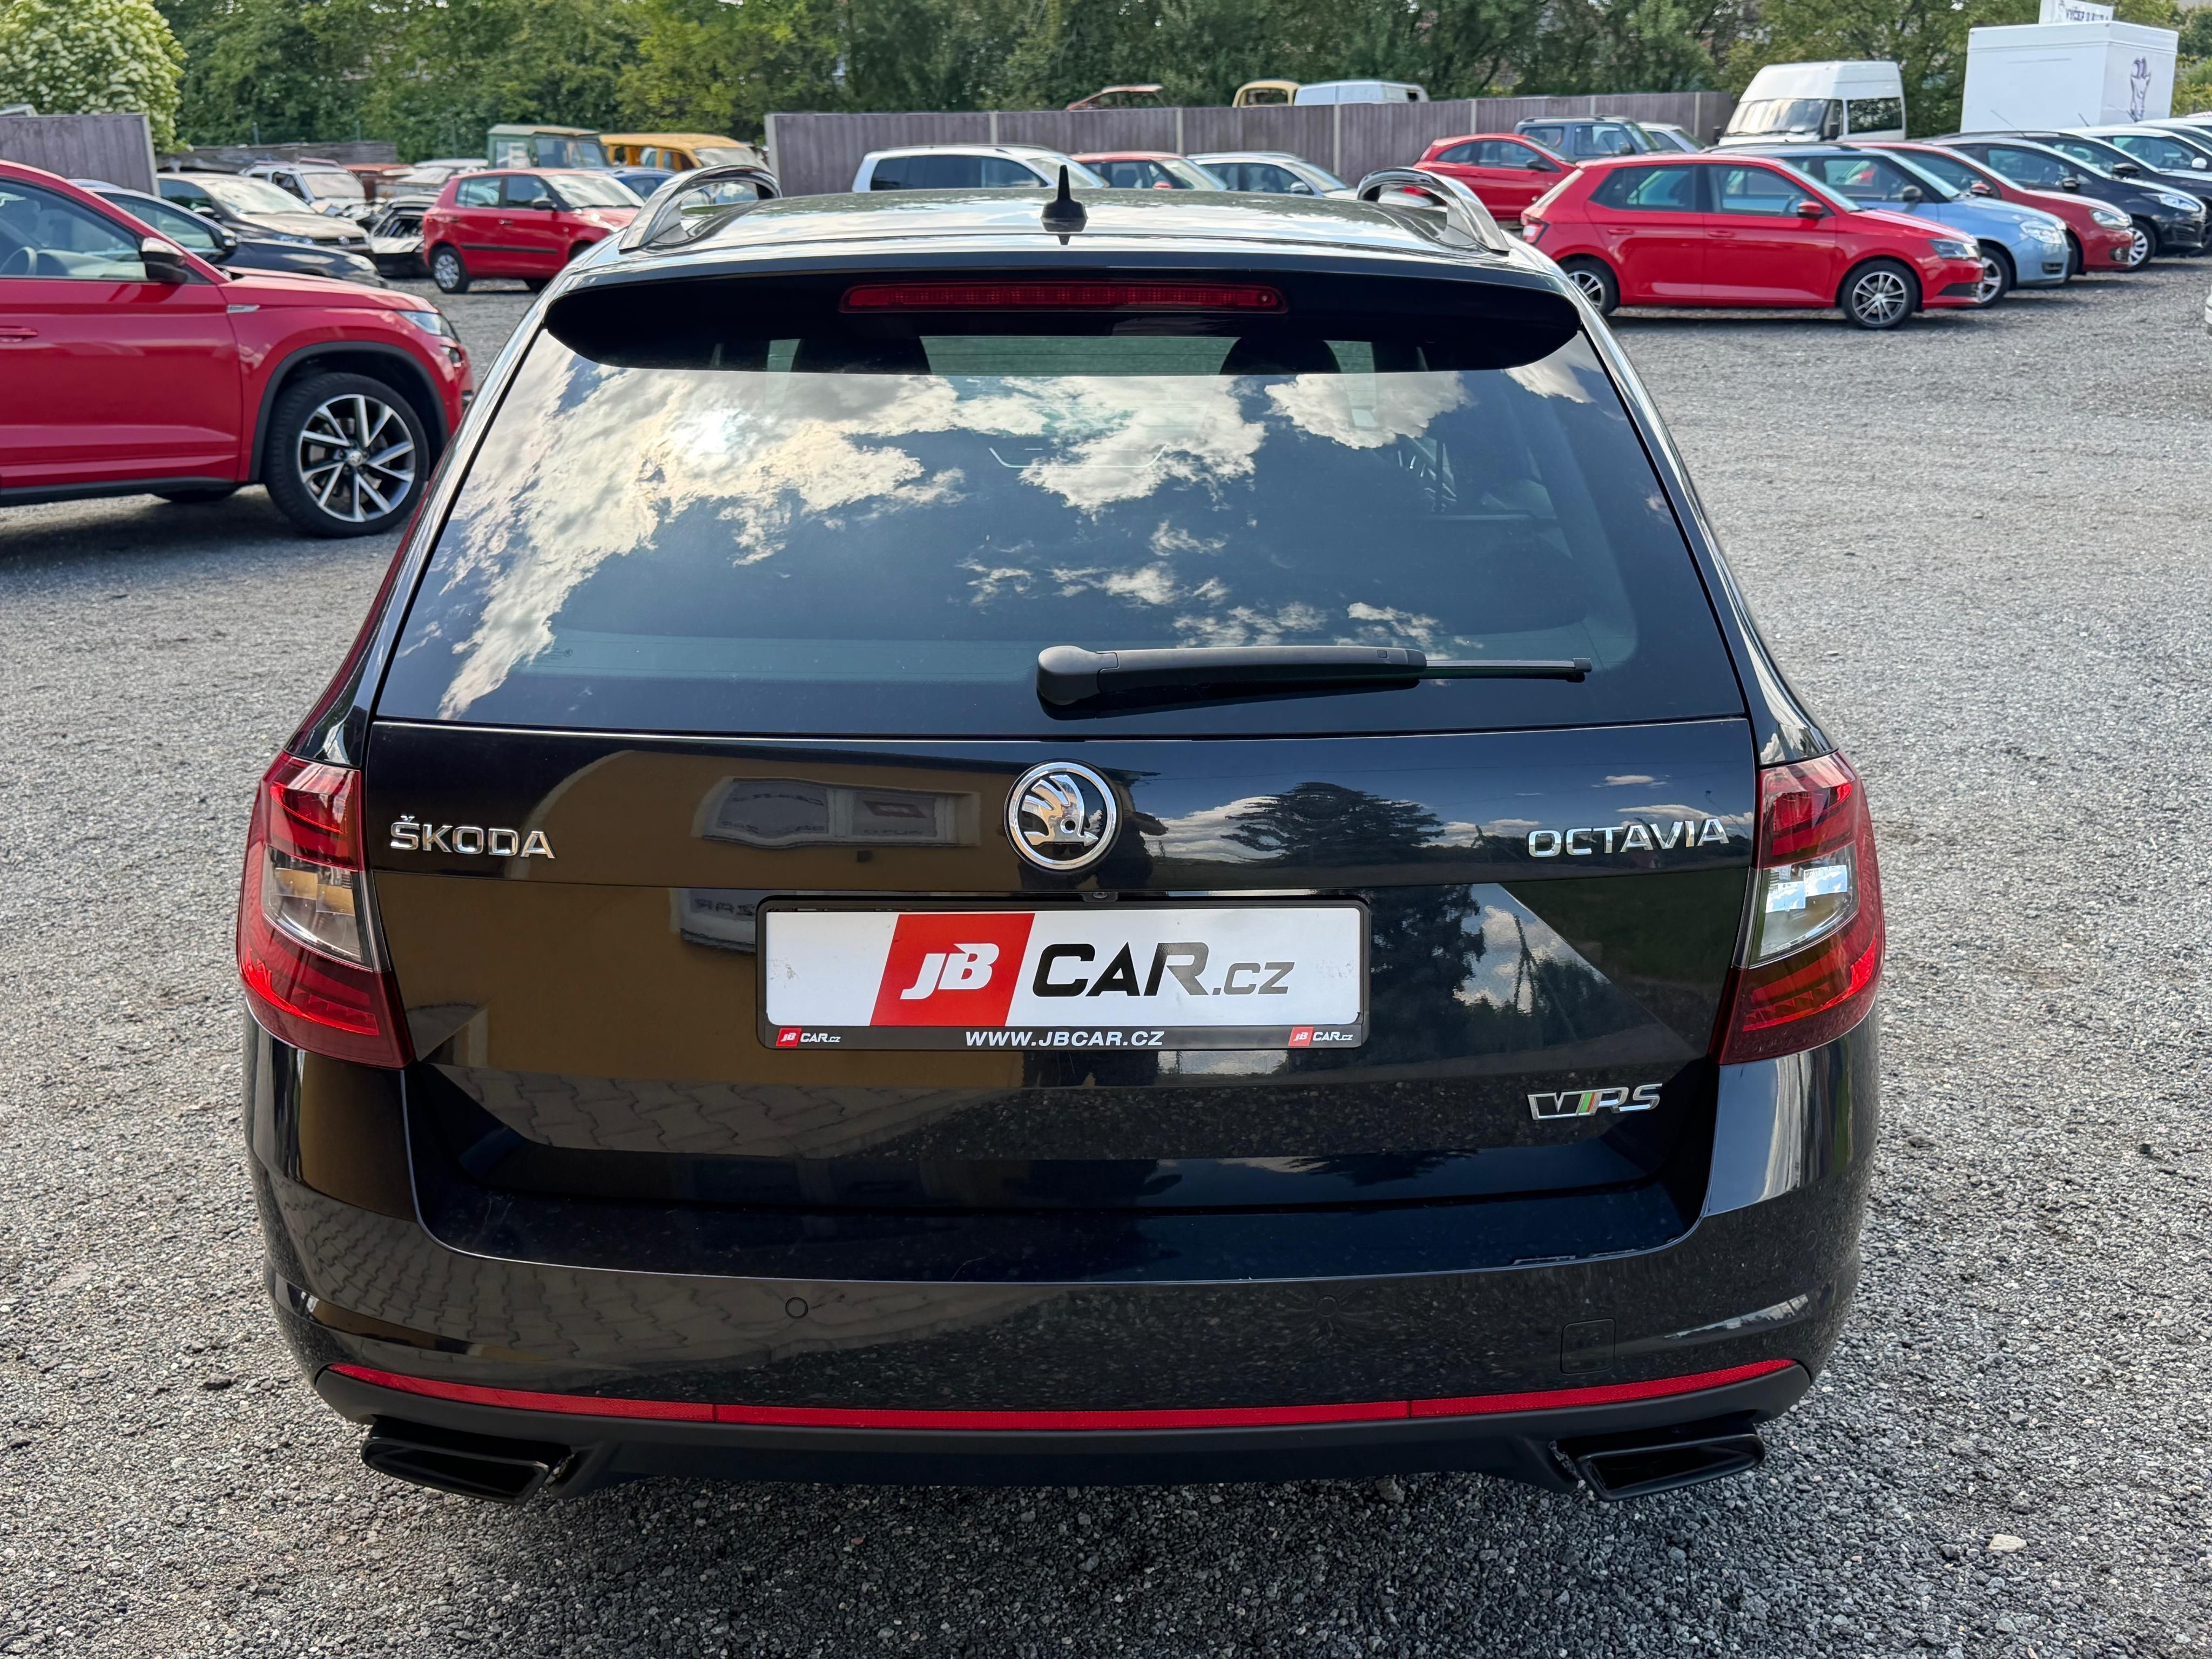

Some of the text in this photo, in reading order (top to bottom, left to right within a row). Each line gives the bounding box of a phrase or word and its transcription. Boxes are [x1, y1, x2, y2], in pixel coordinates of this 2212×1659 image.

[390, 814, 556, 859] ŠKODA
[1528, 818, 1729, 858] OCTAVIA
[900, 943, 999, 1000] JB
[966, 1031, 1165, 1047] WWW.JBCAR.CZ
